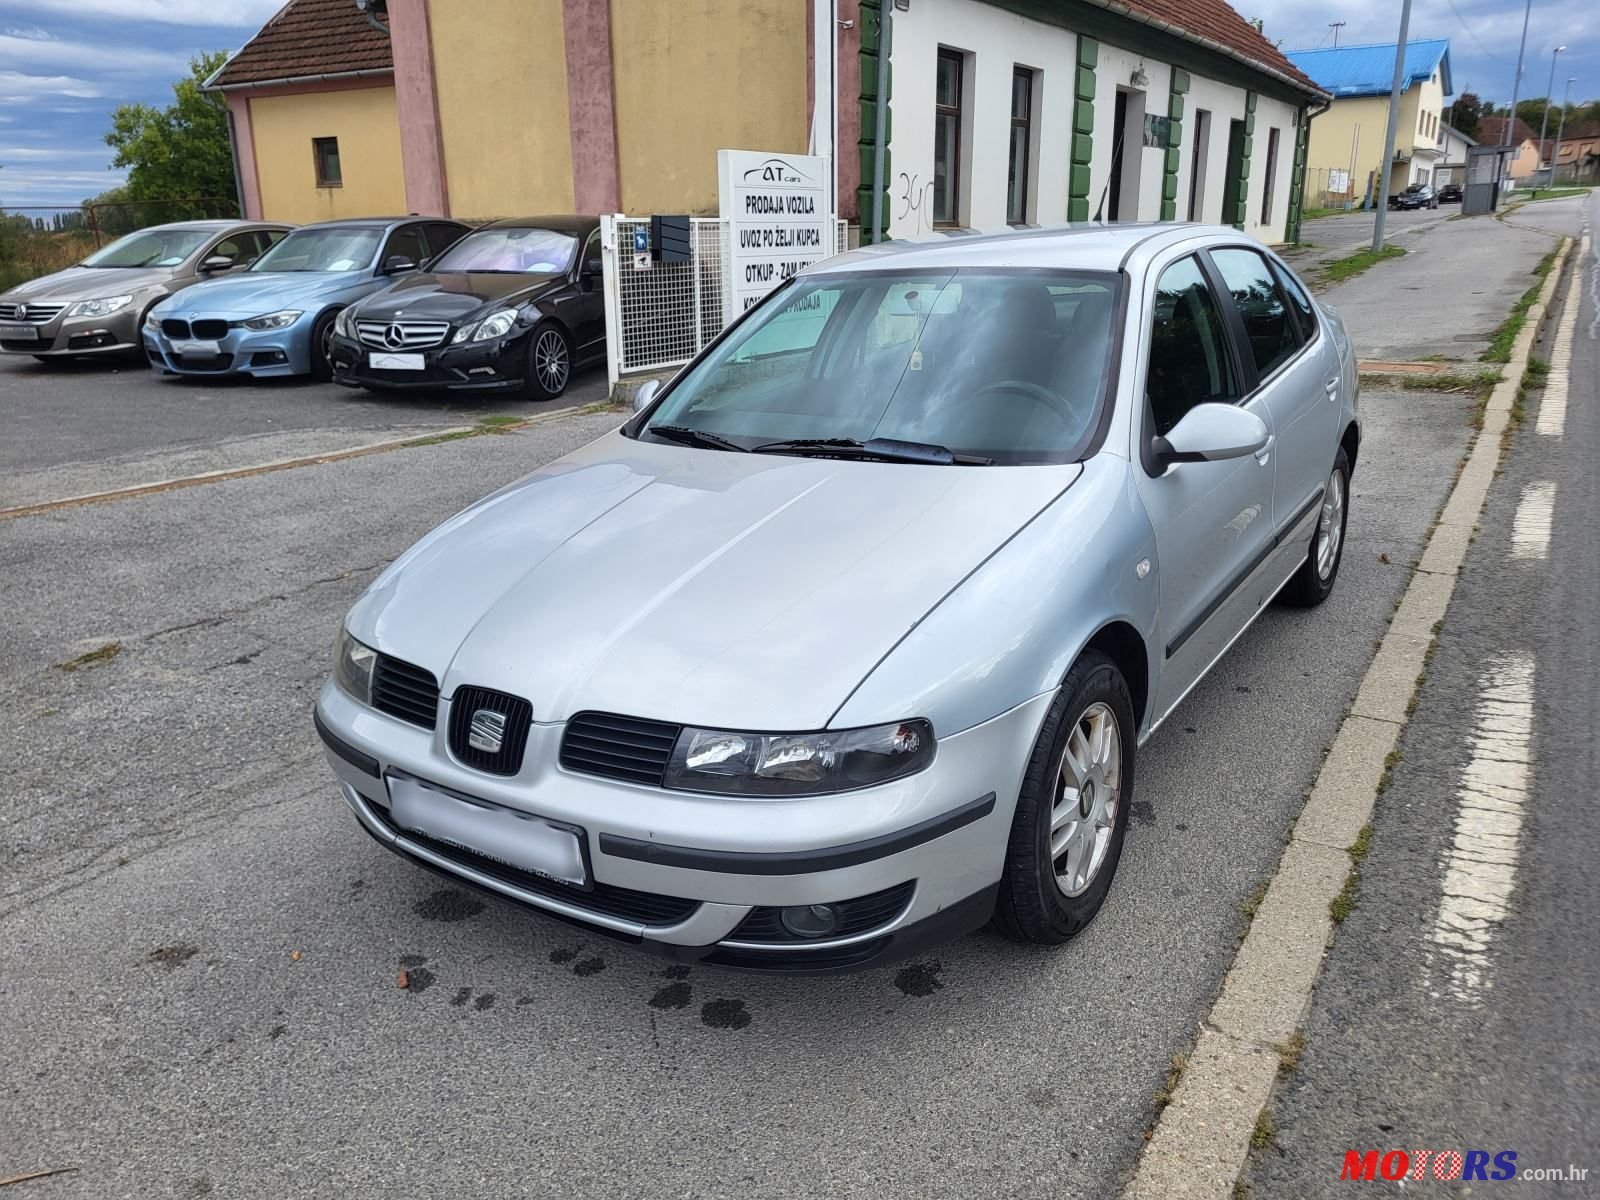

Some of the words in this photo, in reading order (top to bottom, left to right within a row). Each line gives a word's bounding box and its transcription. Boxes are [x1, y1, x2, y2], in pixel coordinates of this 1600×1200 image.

[762, 166, 785, 182] AT
[745, 195, 784, 214] PRODAJA
[786, 196, 815, 214] VOZILA
[740, 229, 762, 248] UVOZ
[763, 229, 773, 247] PO
[775, 225, 795, 247] ŽELJI
[796, 228, 820, 247] KUPCA
[745, 263, 774, 282] OTKUP
